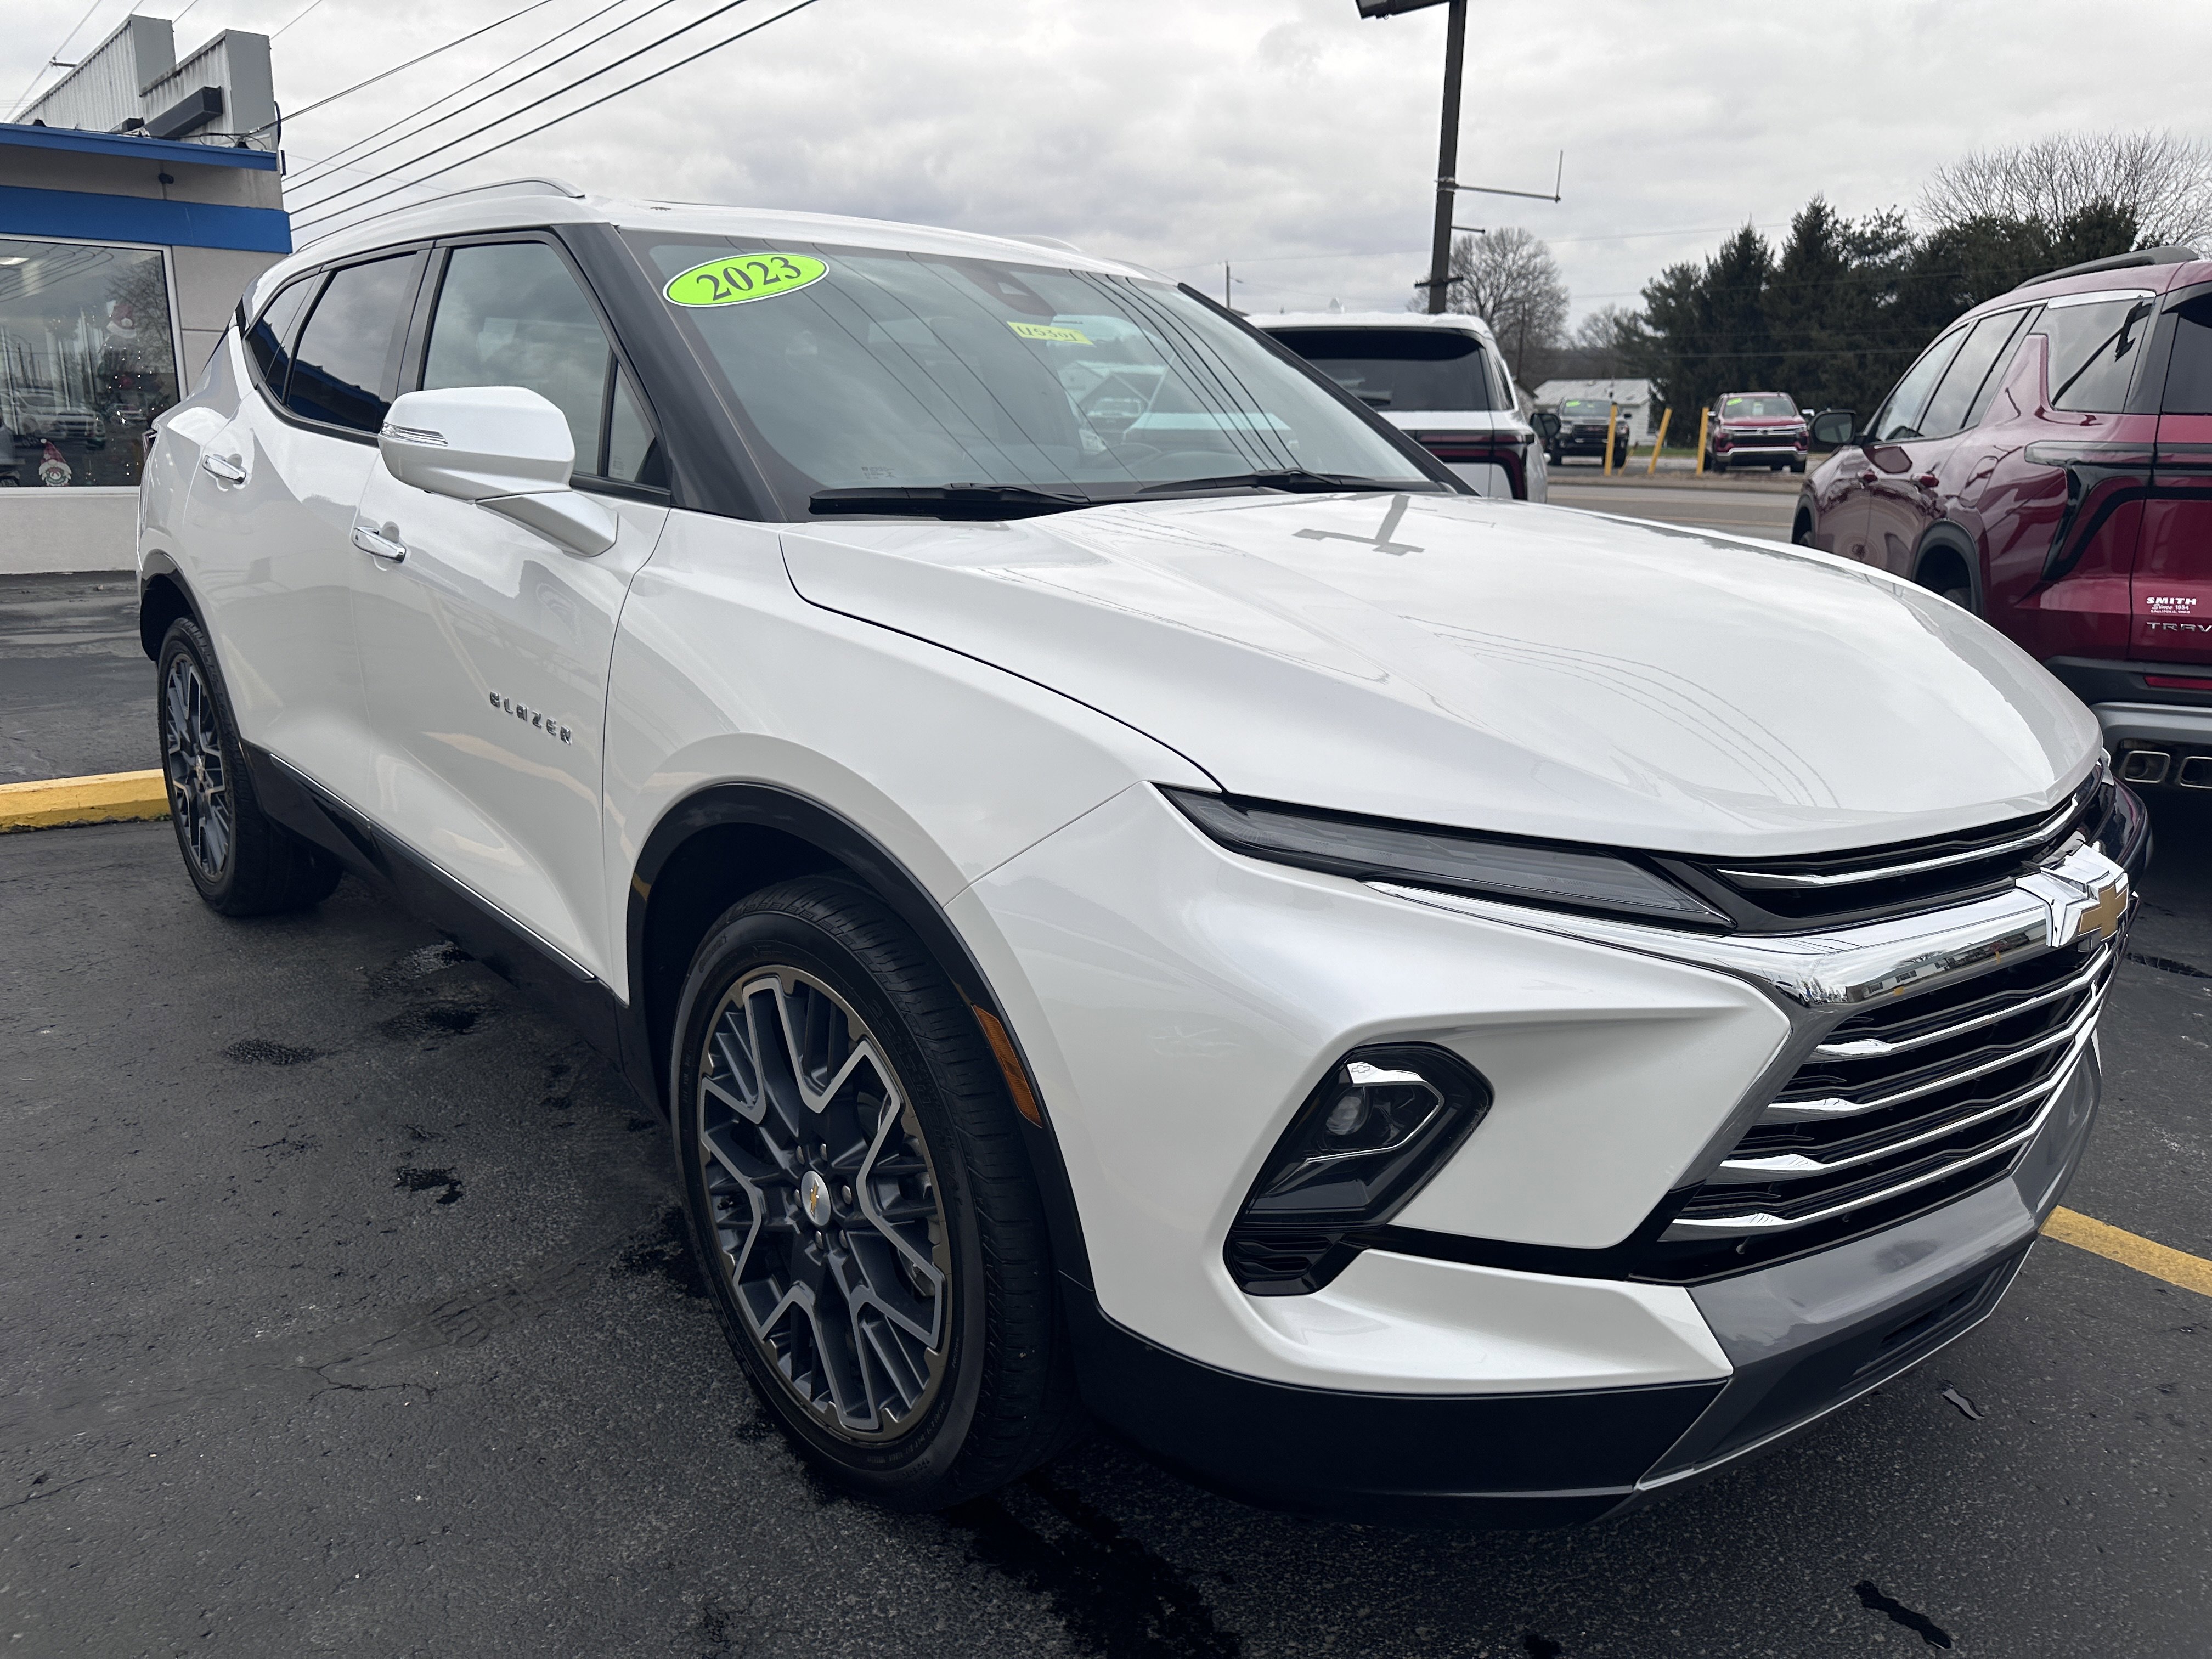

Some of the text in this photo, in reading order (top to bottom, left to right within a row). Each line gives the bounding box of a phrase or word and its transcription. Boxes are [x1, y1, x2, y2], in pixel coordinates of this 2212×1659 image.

[696, 256, 802, 301] 2023
[2146, 597, 2197, 605] SMITH
[489, 690, 572, 746] BLAZER
